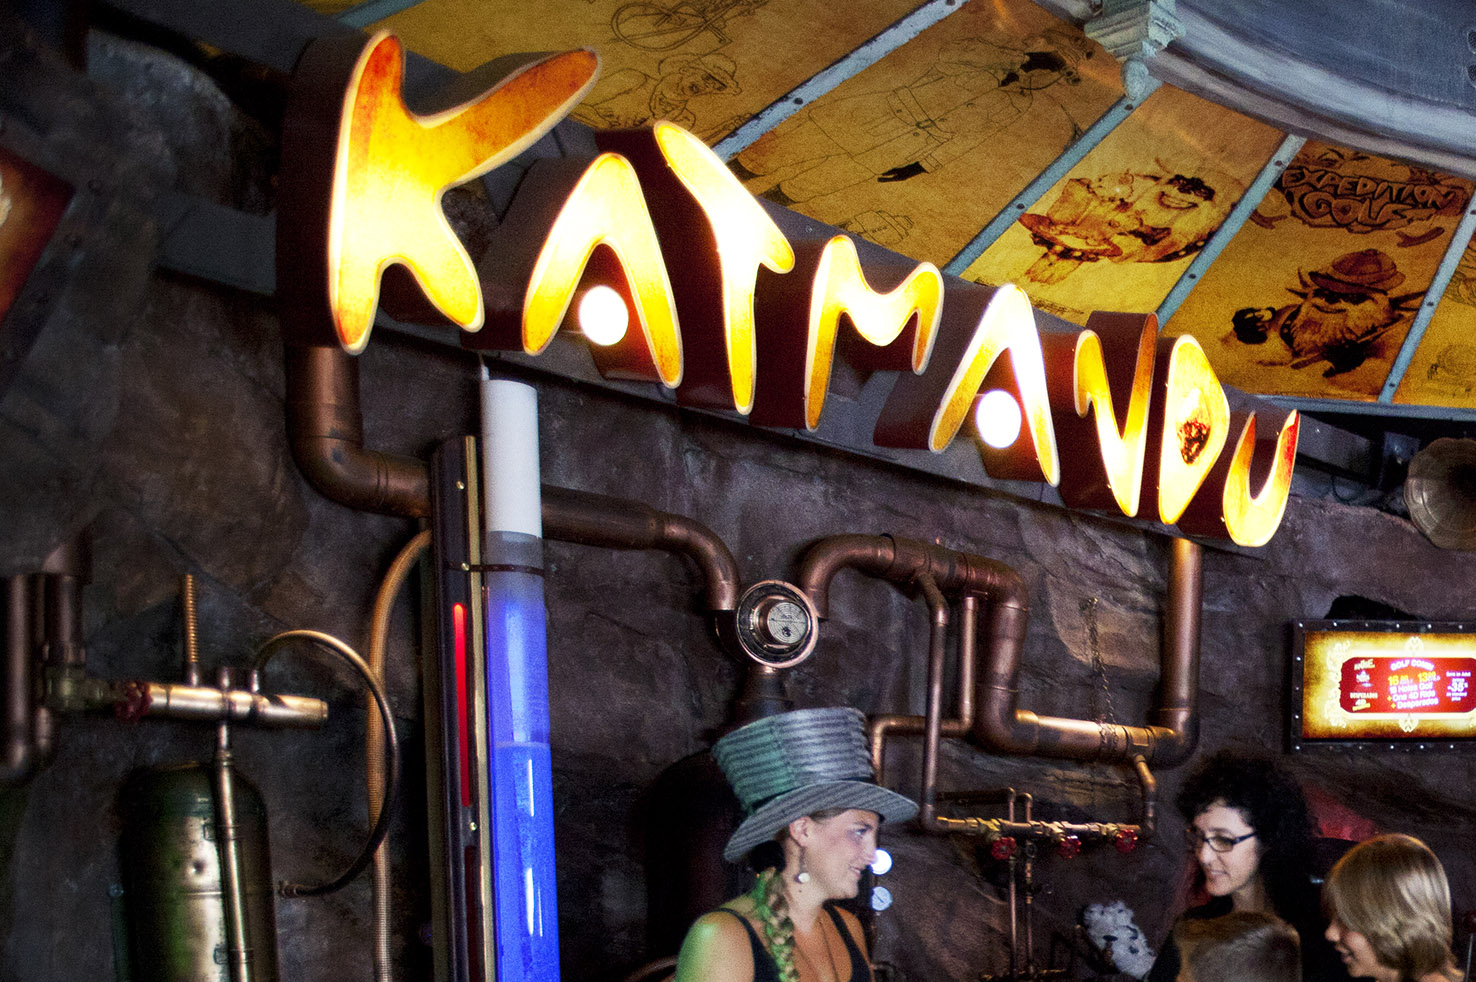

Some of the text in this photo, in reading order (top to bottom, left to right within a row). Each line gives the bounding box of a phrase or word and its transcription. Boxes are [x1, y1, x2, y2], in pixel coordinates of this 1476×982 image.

[1281, 167, 1457, 210] EXPEDITION
[1302, 191, 1437, 227] GOLF
[328, 34, 1300, 547] KATMANDU
